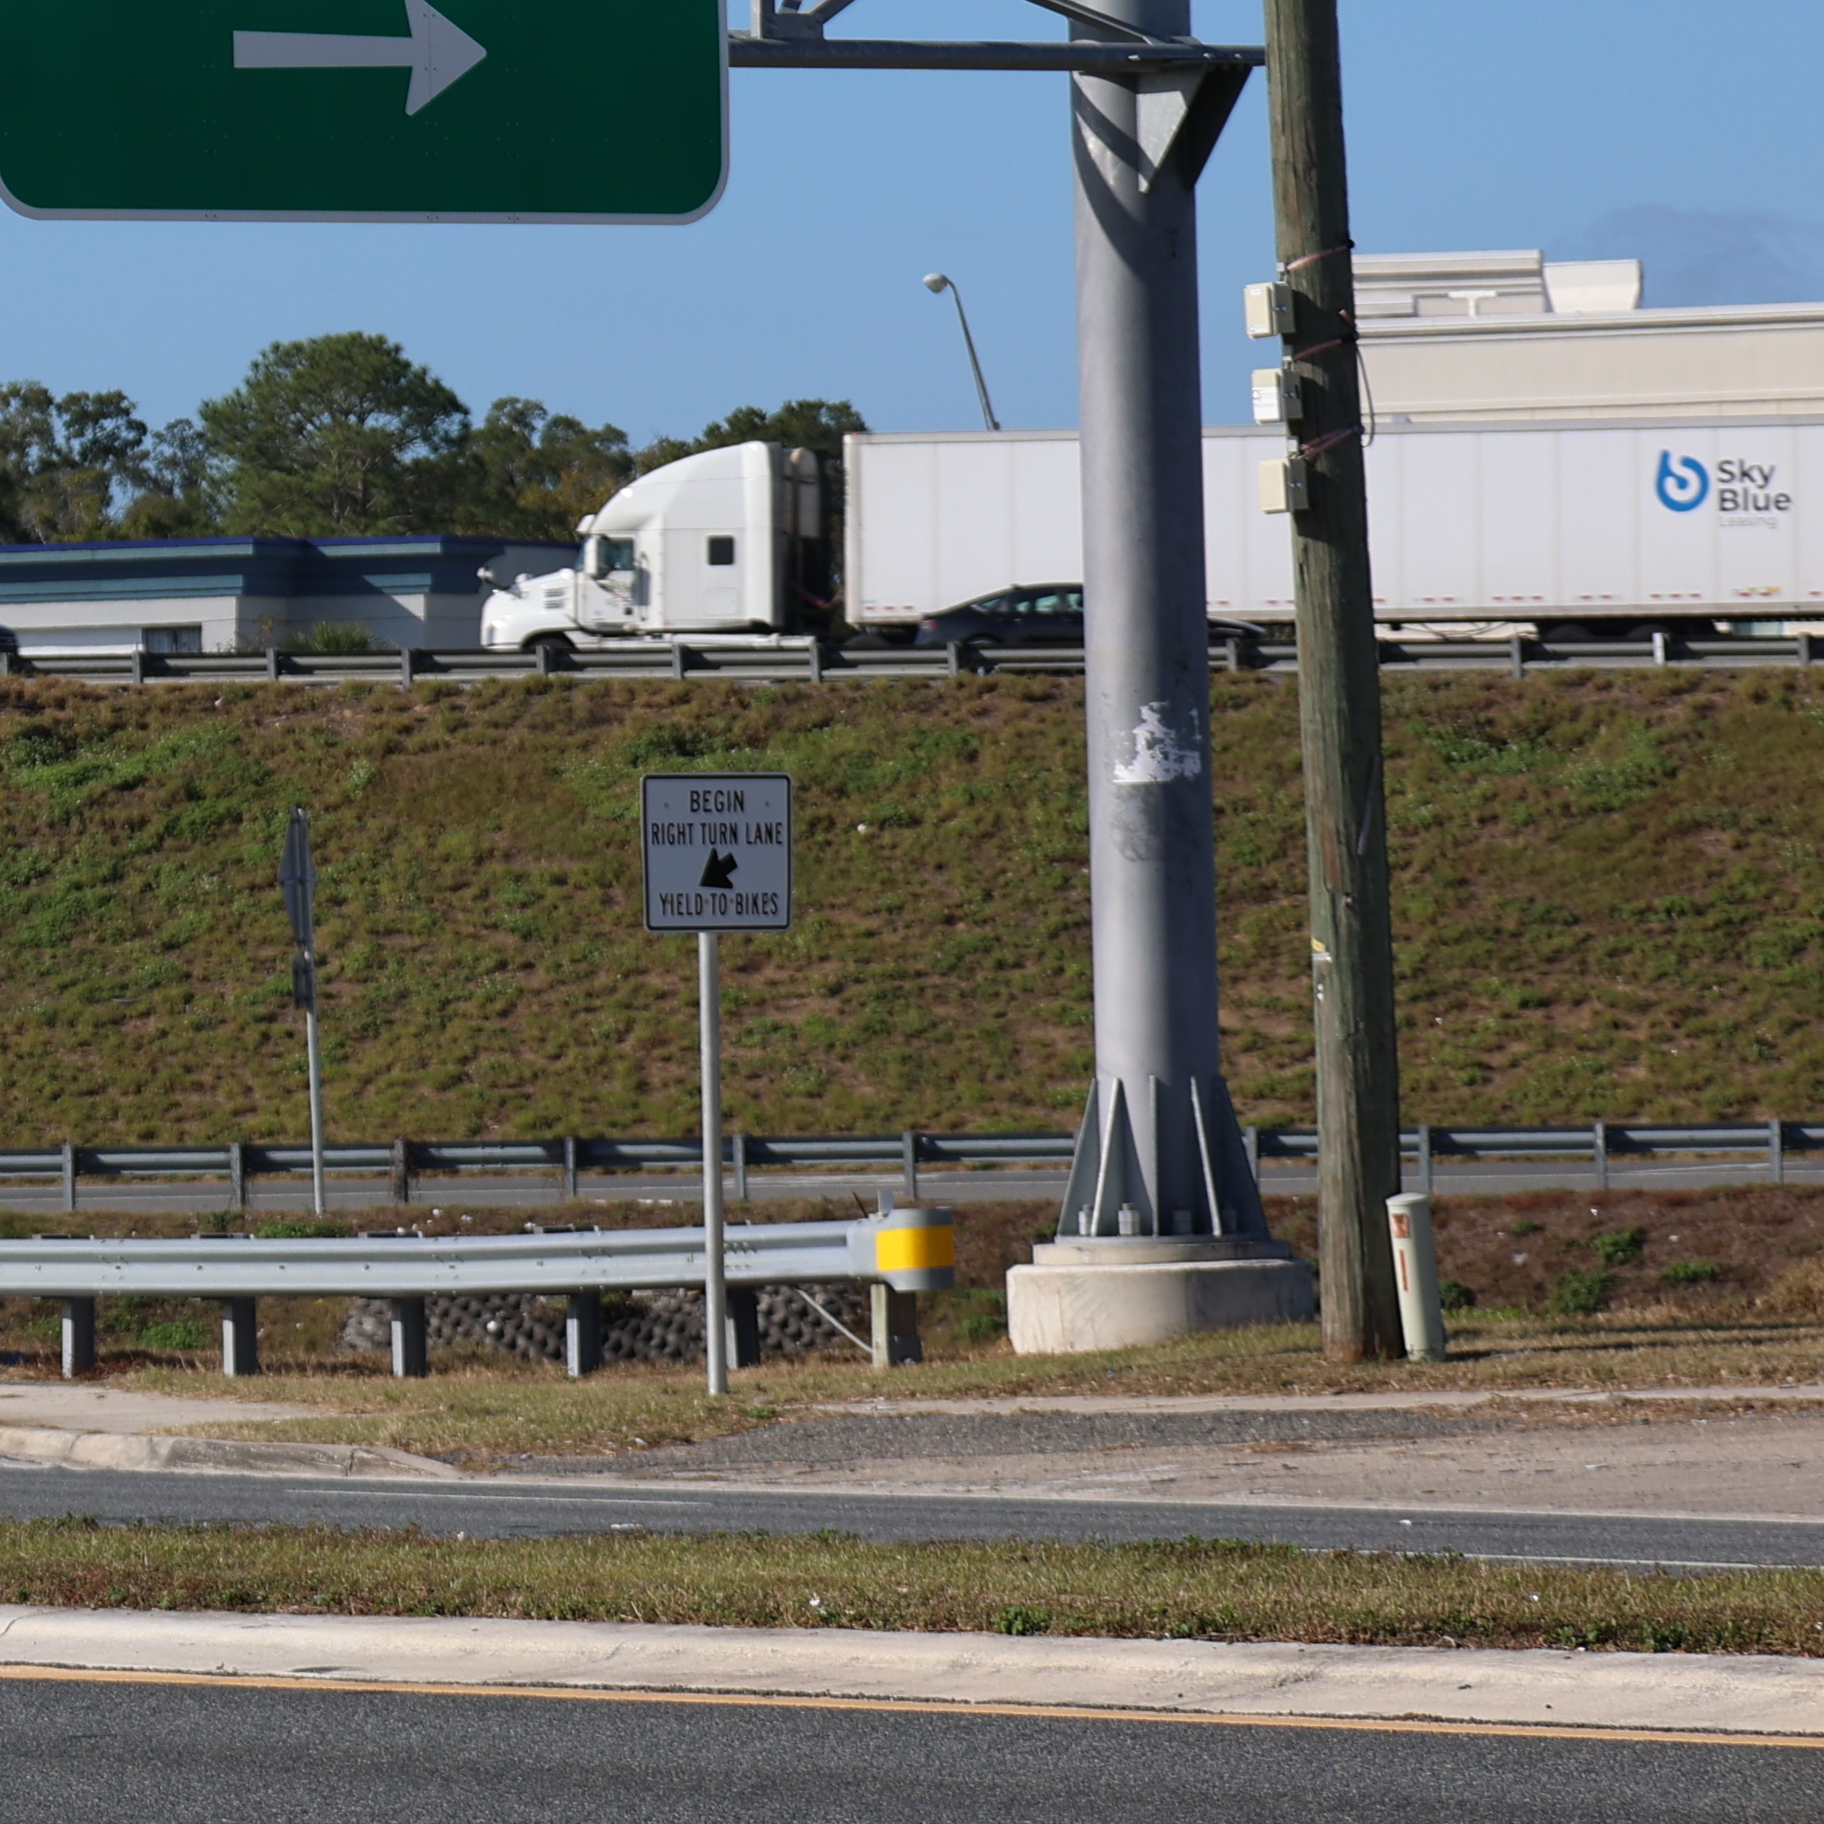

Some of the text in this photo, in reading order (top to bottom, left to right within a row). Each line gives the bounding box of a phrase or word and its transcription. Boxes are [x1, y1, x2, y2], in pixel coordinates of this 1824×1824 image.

[1716, 458, 1776, 490] Sky
[1718, 487, 1792, 512] Blue
[689, 789, 745, 813] BEGIN
[651, 822, 783, 846] RIGHT TURN LANE
[658, 892, 779, 917] YIELD TO BIKES
